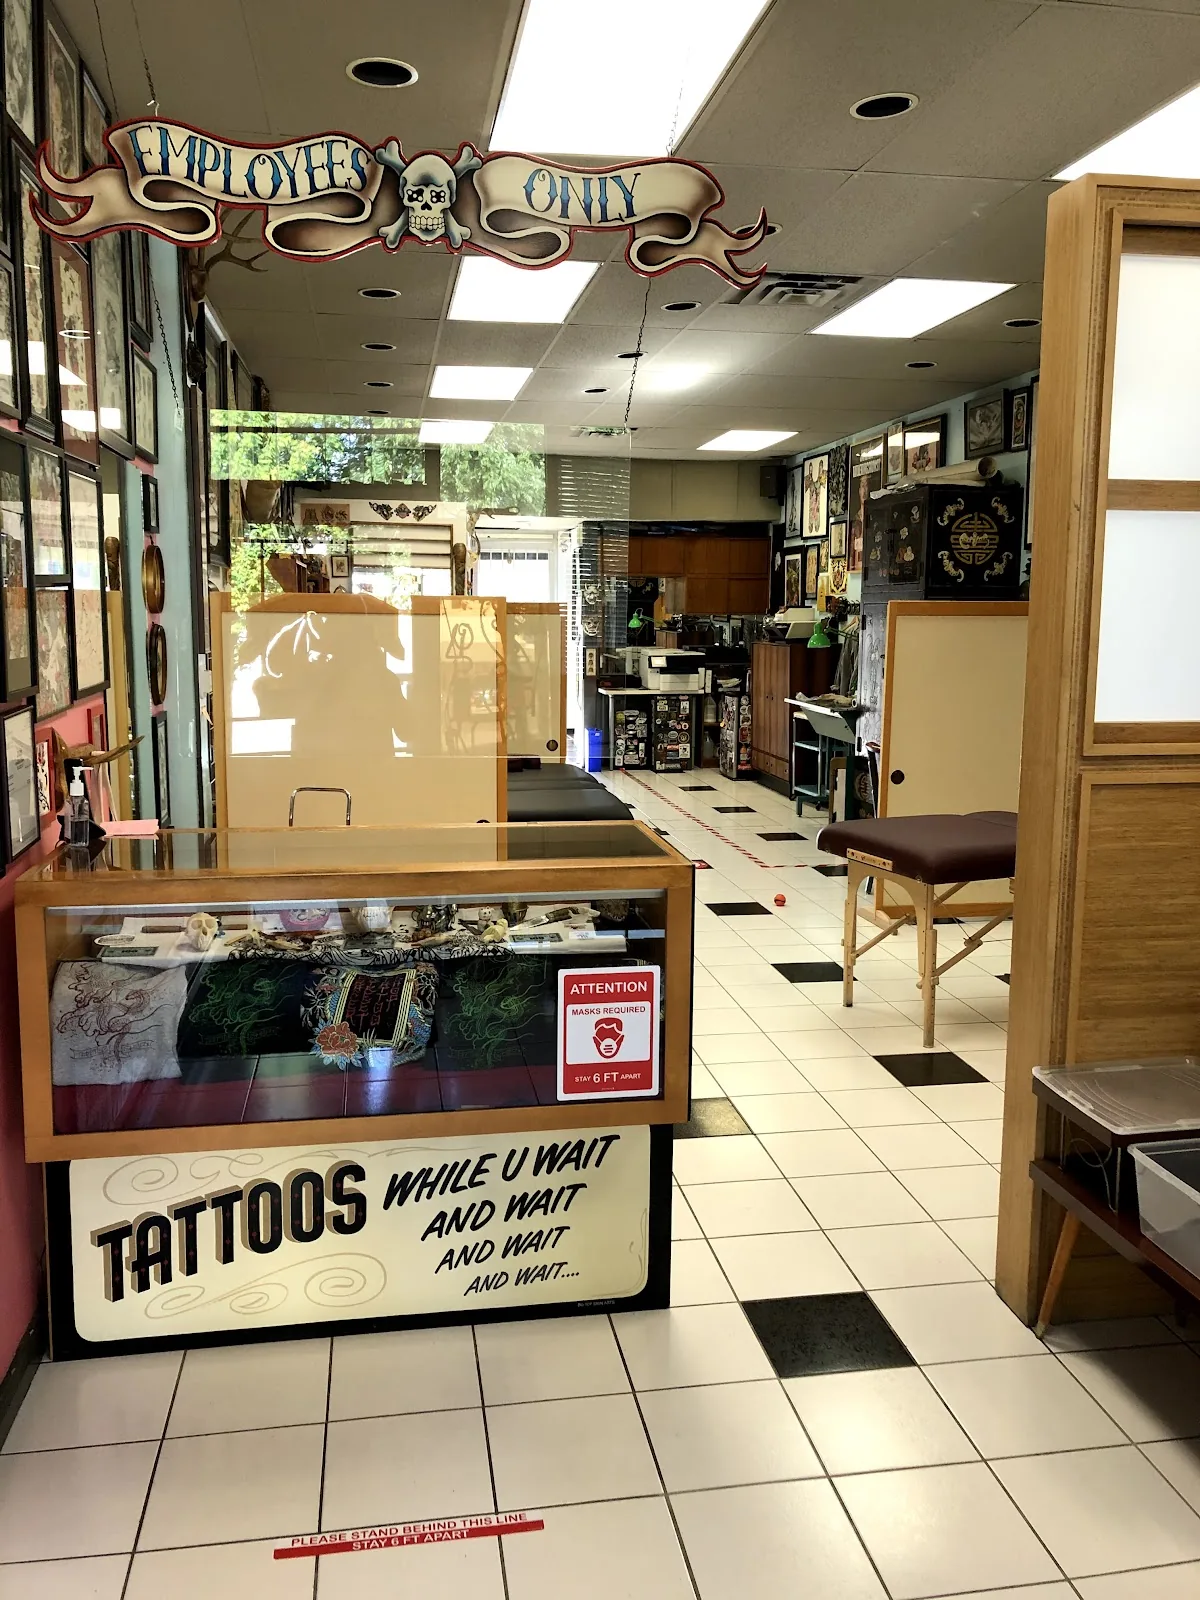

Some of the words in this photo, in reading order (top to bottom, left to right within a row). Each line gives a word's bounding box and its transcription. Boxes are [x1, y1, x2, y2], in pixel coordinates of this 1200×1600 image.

[127, 124, 374, 200] EMPLOYEES
[523, 168, 643, 224] ONLY
[570, 981, 648, 995] ATTENTION
[571, 1008, 601, 1016] MASKS
[602, 1006, 646, 1014] REQUIRED
[592, 1072, 601, 1083] 6
[603, 1072, 619, 1083] FT
[383, 1153, 497, 1211] WHILE
[501, 1146, 530, 1182] U
[532, 1134, 620, 1177] WAIT
[421, 1200, 496, 1242] AND
[503, 1183, 588, 1223] WAIT
[90, 1160, 367, 1303] TATTOOS
[434, 1239, 495, 1275] AND
[501, 1226, 570, 1260] WAIT
[463, 1271, 509, 1297] AND
[514, 1261, 580, 1287] WAIT....
[291, 1532, 347, 1547] PLEASE
[350, 1527, 399, 1541] STAND
[402, 1521, 457, 1535] BEHIND
[460, 1517, 493, 1530] THIS
[495, 1513, 528, 1526] LINE
[351, 1538, 389, 1551] STAY
[390, 1537, 400, 1547] 6
[402, 1534, 421, 1546] FT
[423, 1529, 470, 1545] APART
